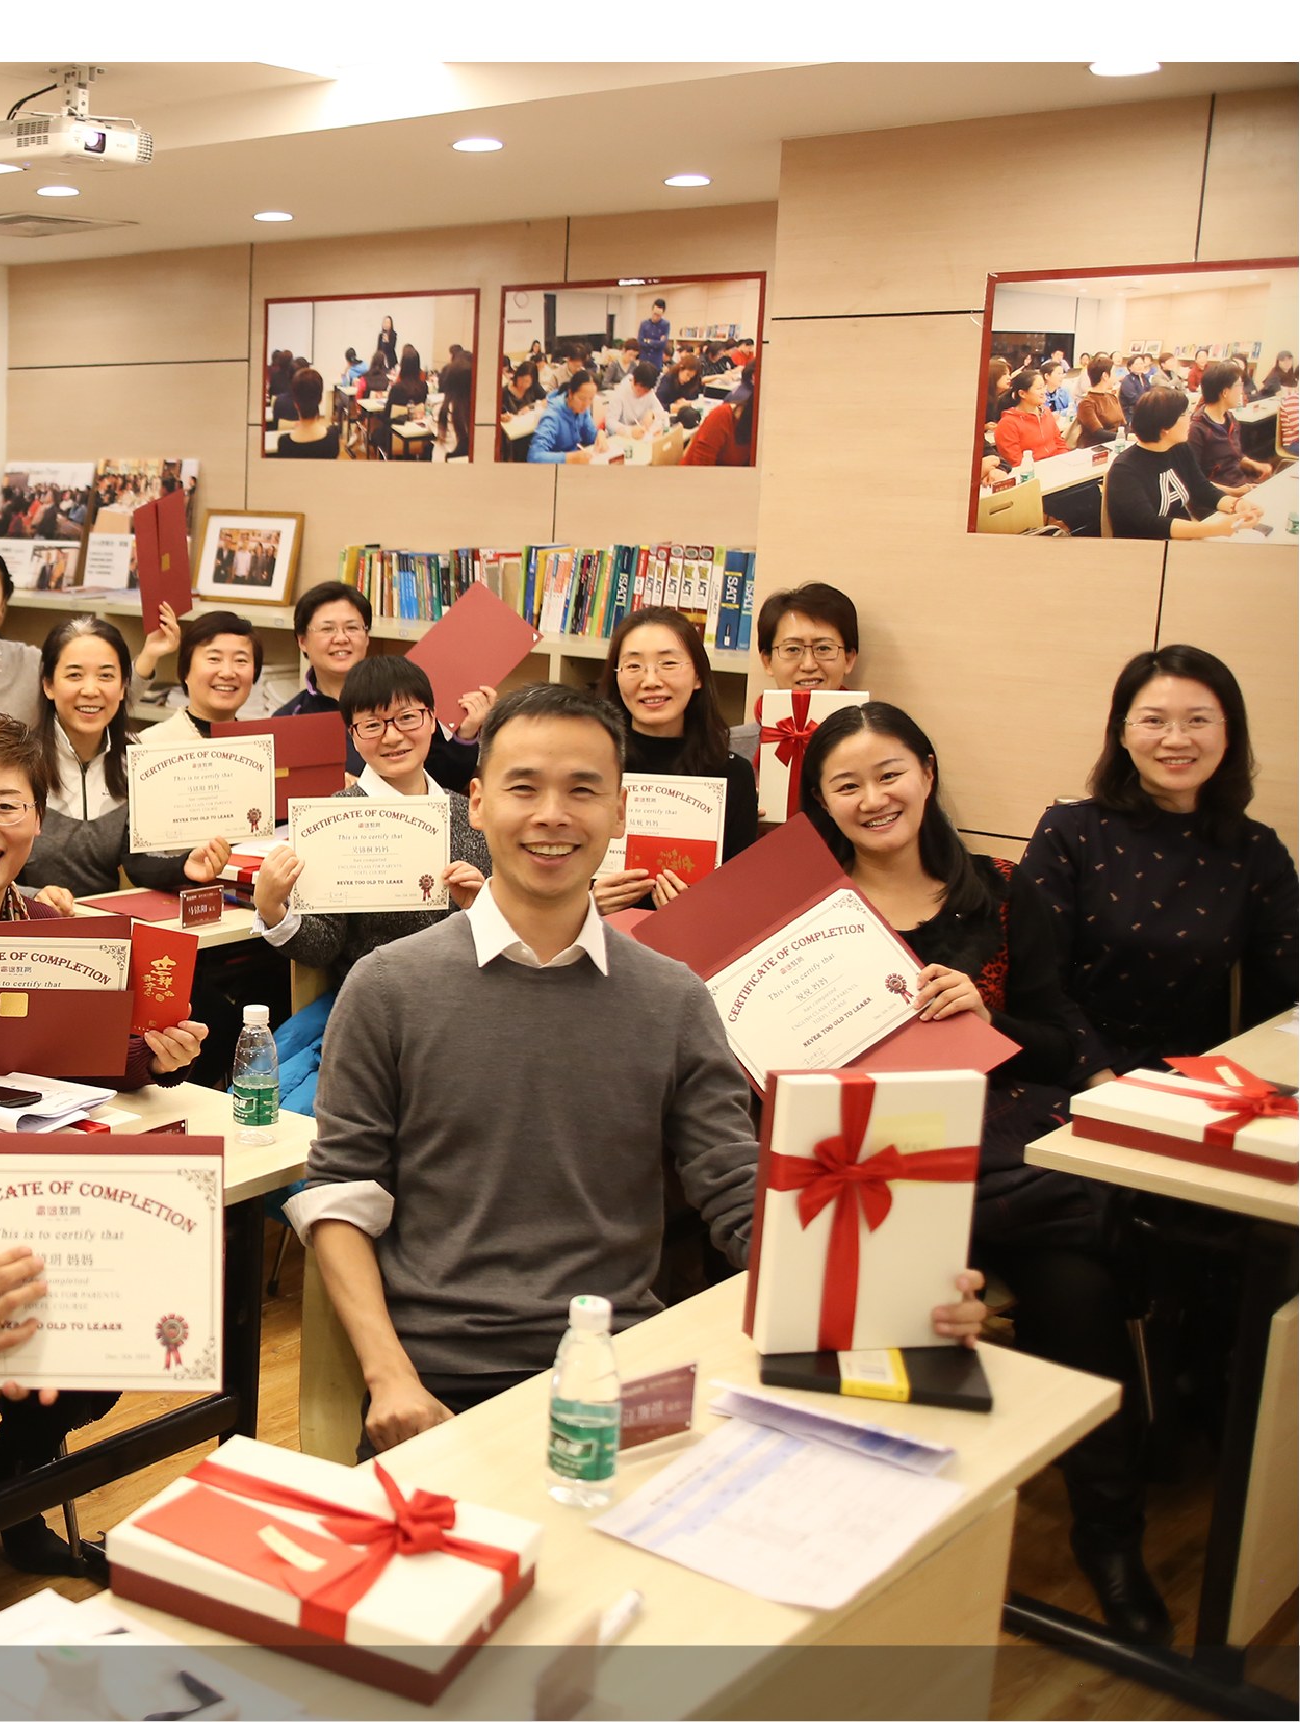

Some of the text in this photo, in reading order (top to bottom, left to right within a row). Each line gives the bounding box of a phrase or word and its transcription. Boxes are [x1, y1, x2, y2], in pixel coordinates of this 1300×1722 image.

[667, 578, 677, 595] ACT
[683, 580, 692, 597] ACT
[698, 581, 707, 597] ACT
[725, 575, 739, 604] SAT
[744, 584, 755, 610] SAT
[140, 752, 196, 782] CERTIFICATE
[211, 751, 265, 772] COMPLETION
[641, 784, 654, 793] OF
[656, 786, 713, 815] COMPLETION
[301, 809, 439, 838] CERTIFICATE OF COMPLETION
[10, 952, 29, 961] OF
[31, 953, 112, 985] COMPLETION
[727, 957, 778, 1023] CERTIFICATE
[777, 945, 791, 960] OF
[791, 923, 866, 951] COMPLETION
[768, 989, 785, 1001] This
[800, 962, 822, 981] certify
[822, 953, 836, 965] that
[13, 980, 42, 989] certify
[822, 1024, 834, 1035] TOO
[834, 1016, 845, 1027] OLD
[49, 1180, 74, 1195] OF
[79, 1182, 198, 1236] COMPLETION
[25, 1229, 34, 1240] is
[39, 1229, 50, 1240] to
[55, 1229, 96, 1243] certify
[101, 1229, 124, 1241] that
[47, 1322, 67, 1331] OLD
[71, 1322, 84, 1331] TO
